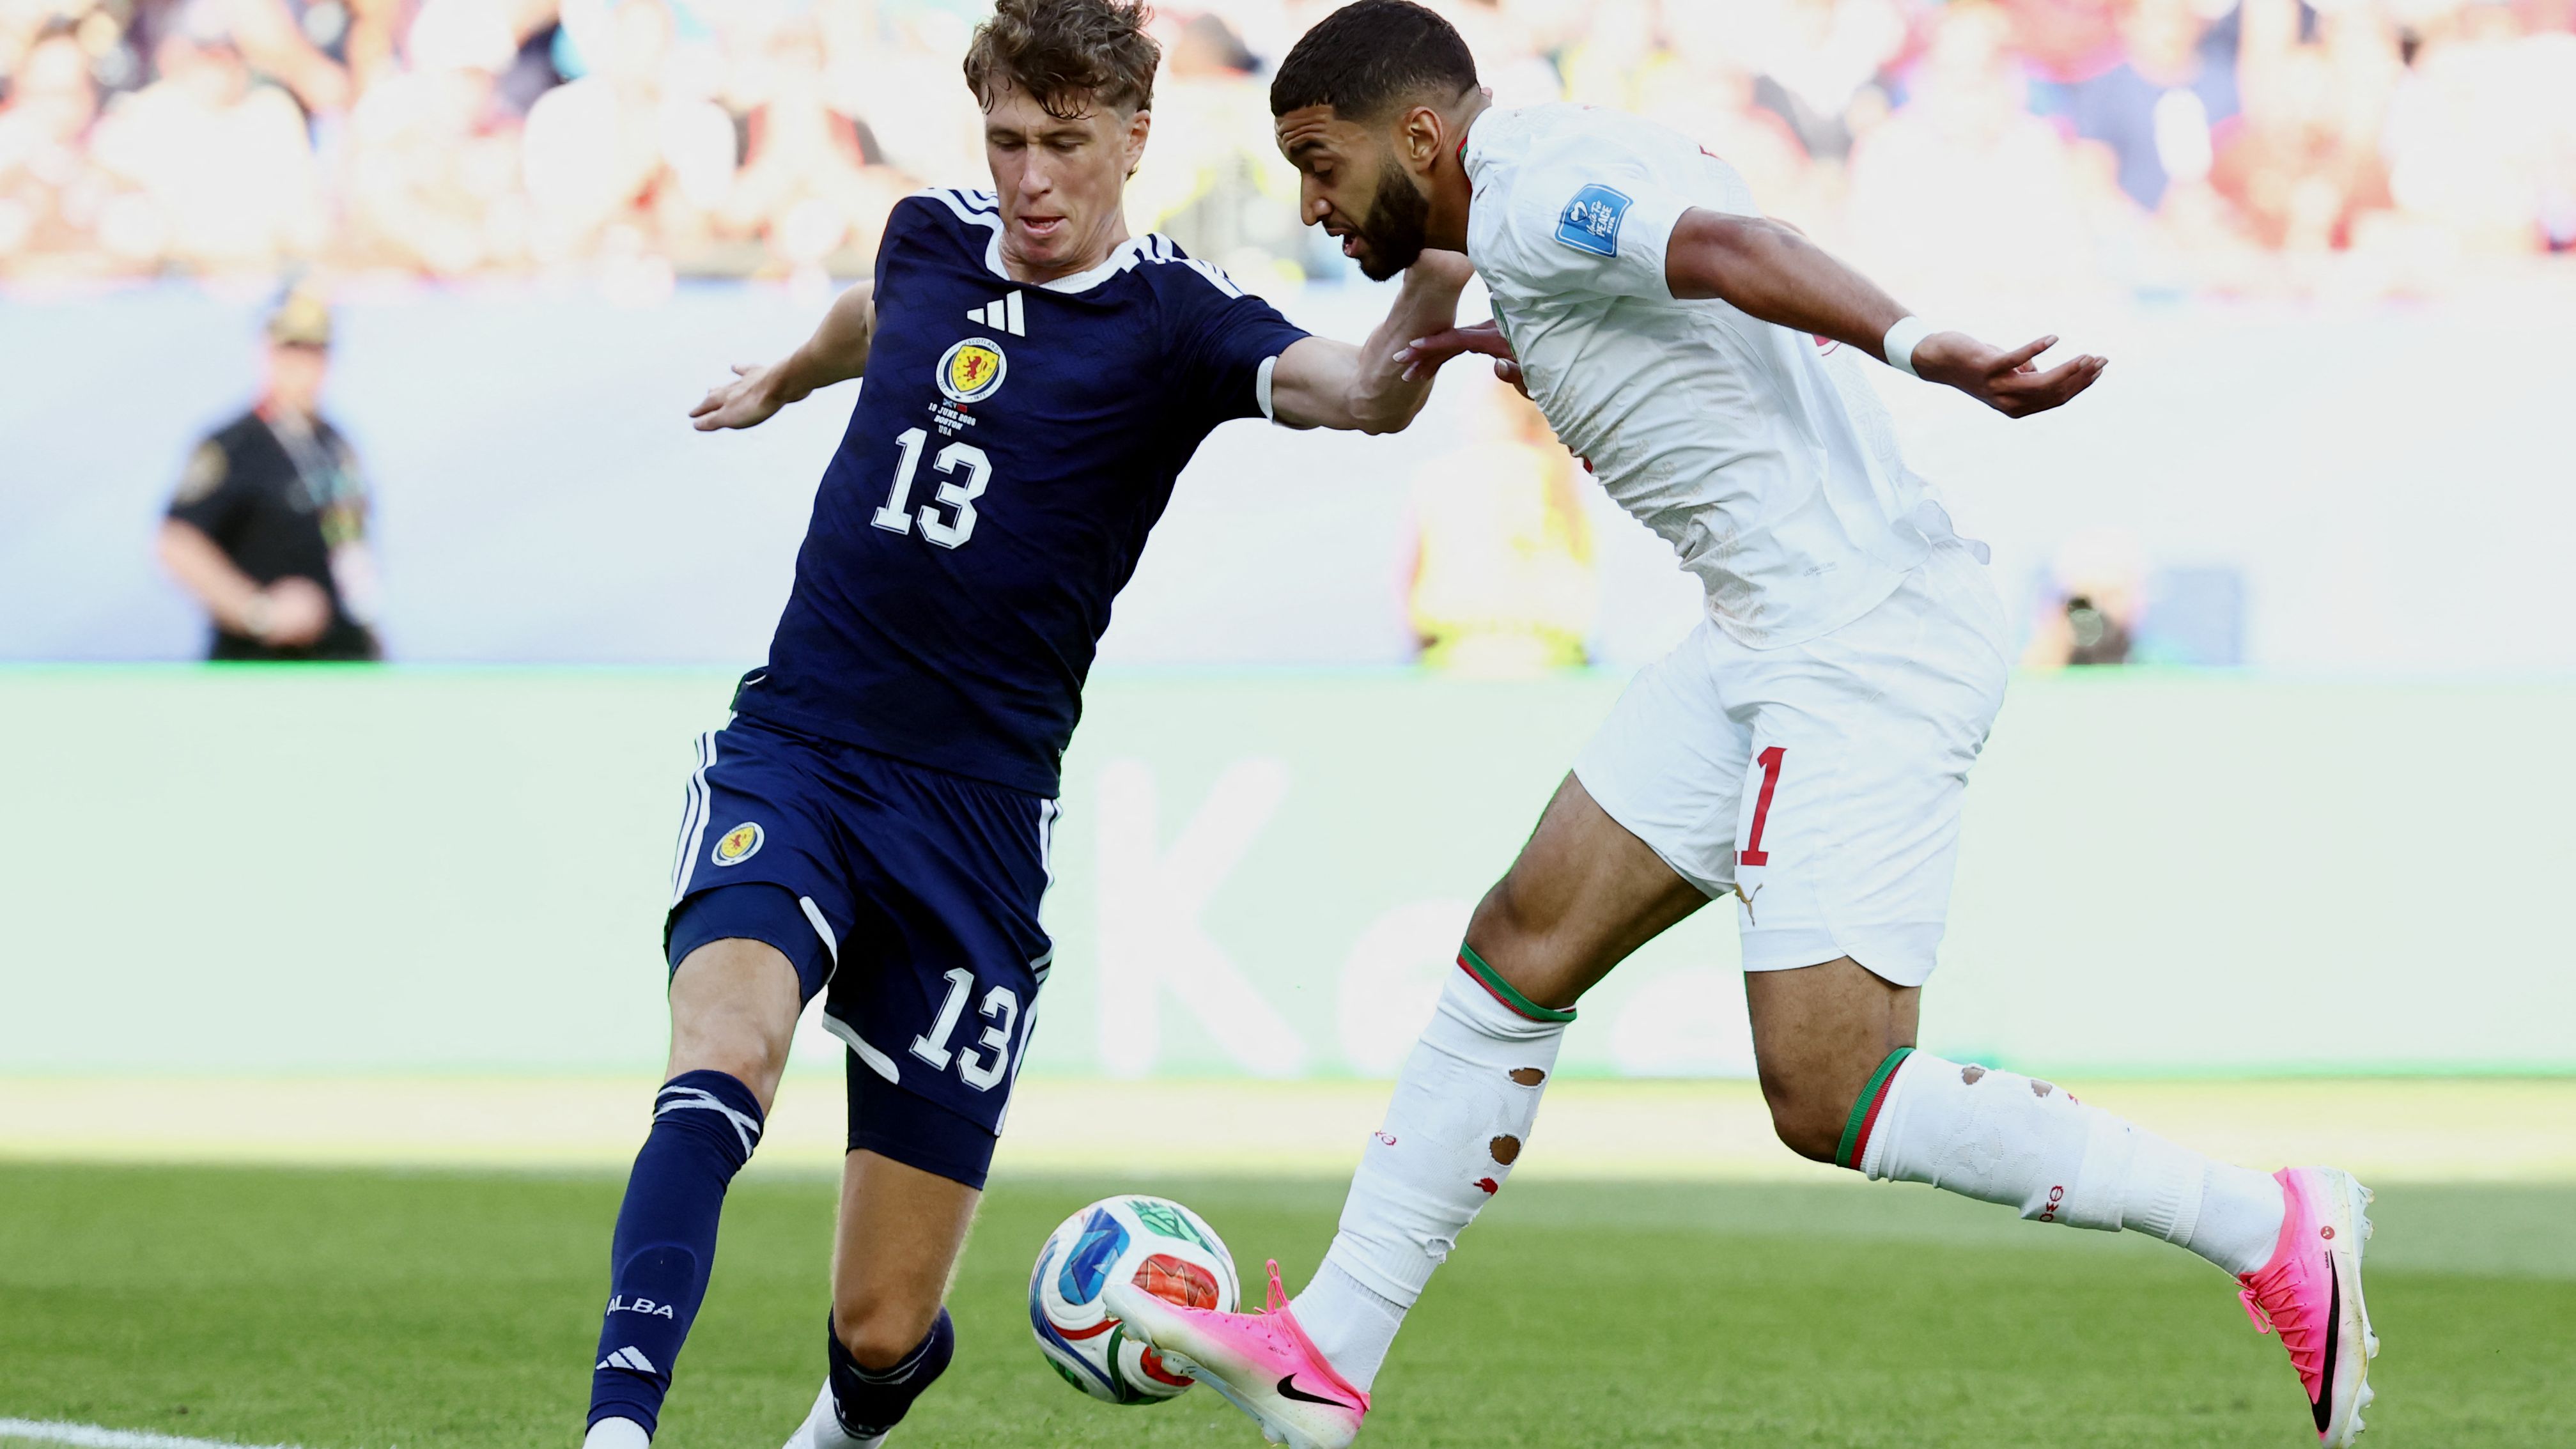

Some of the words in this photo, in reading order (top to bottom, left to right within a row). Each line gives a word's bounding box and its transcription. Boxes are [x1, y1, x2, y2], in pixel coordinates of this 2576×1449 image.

[1596, 205, 1613, 237] PEACE
[1606, 216, 1616, 234] FIFA
[968, 339, 998, 352] SCOTLAND
[934, 415, 963, 430] BOSTON
[938, 407, 958, 419] JUNE
[958, 414, 976, 426] 2026
[938, 424, 952, 437] USA
[870, 427, 993, 550] 13
[1733, 747, 1788, 866] 1
[908, 967, 1018, 1092] 13
[607, 1294, 673, 1319] ALBA
